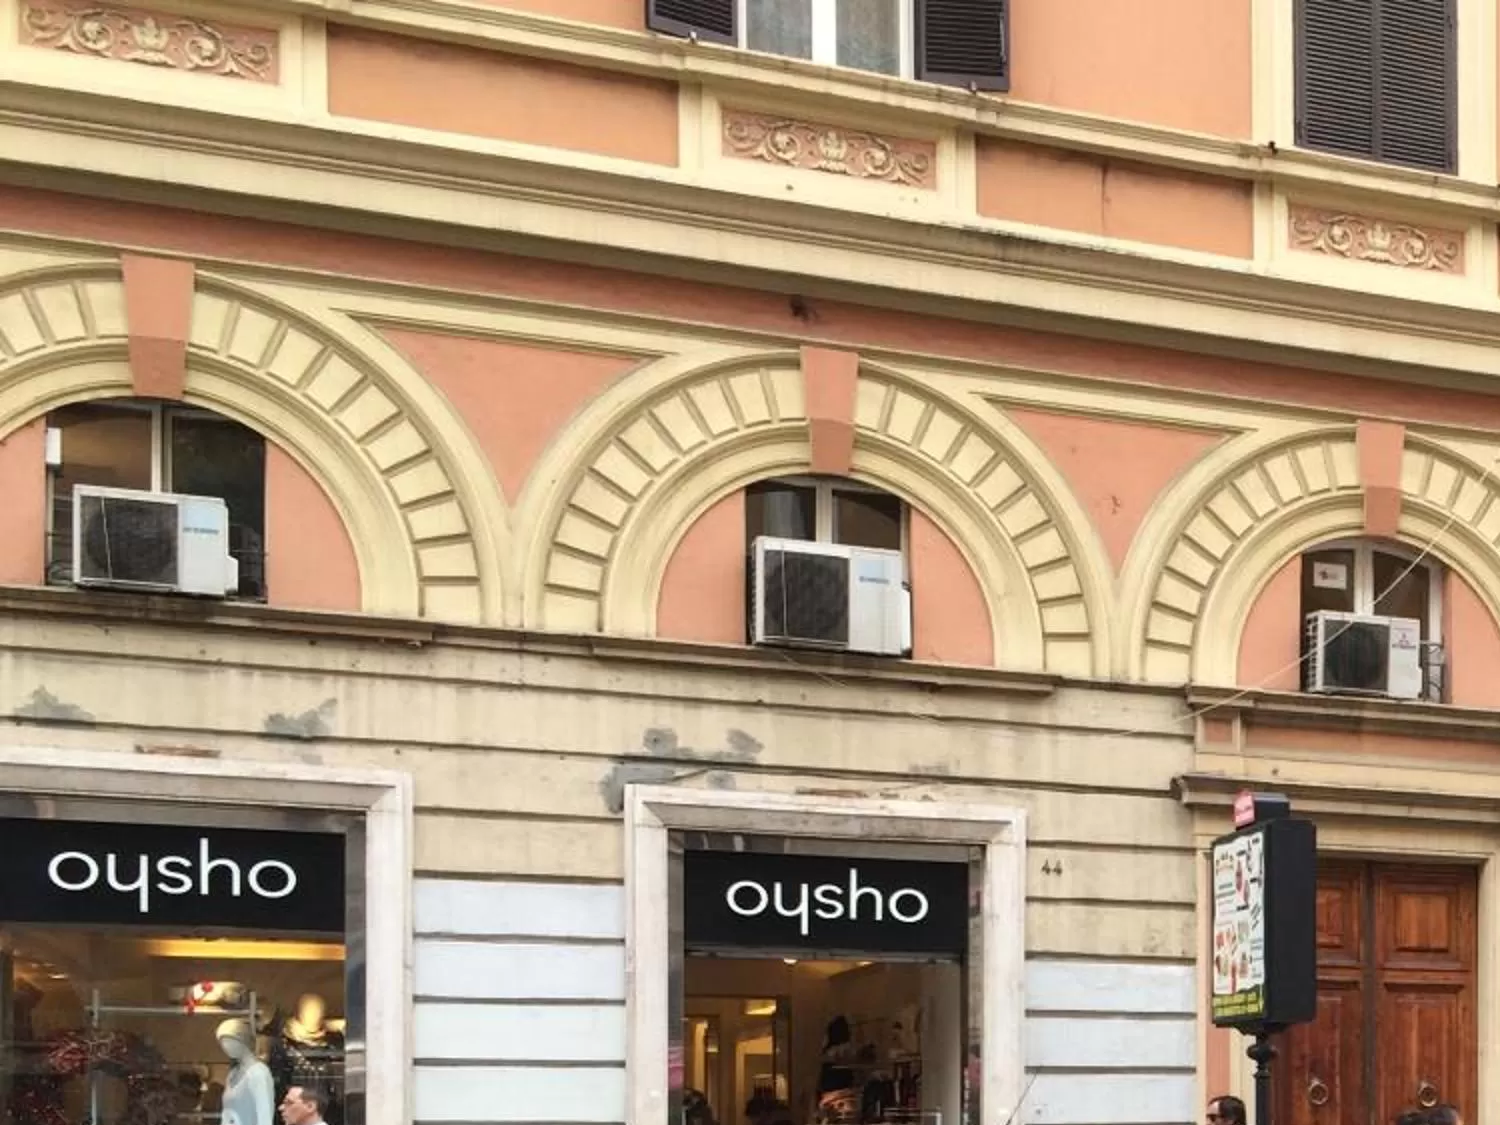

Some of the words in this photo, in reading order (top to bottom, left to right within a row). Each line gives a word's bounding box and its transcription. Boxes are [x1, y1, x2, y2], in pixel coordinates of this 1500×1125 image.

[47, 837, 298, 913] oysho
[726, 867, 929, 936] oysho
[1040, 858, 1063, 877] 44
